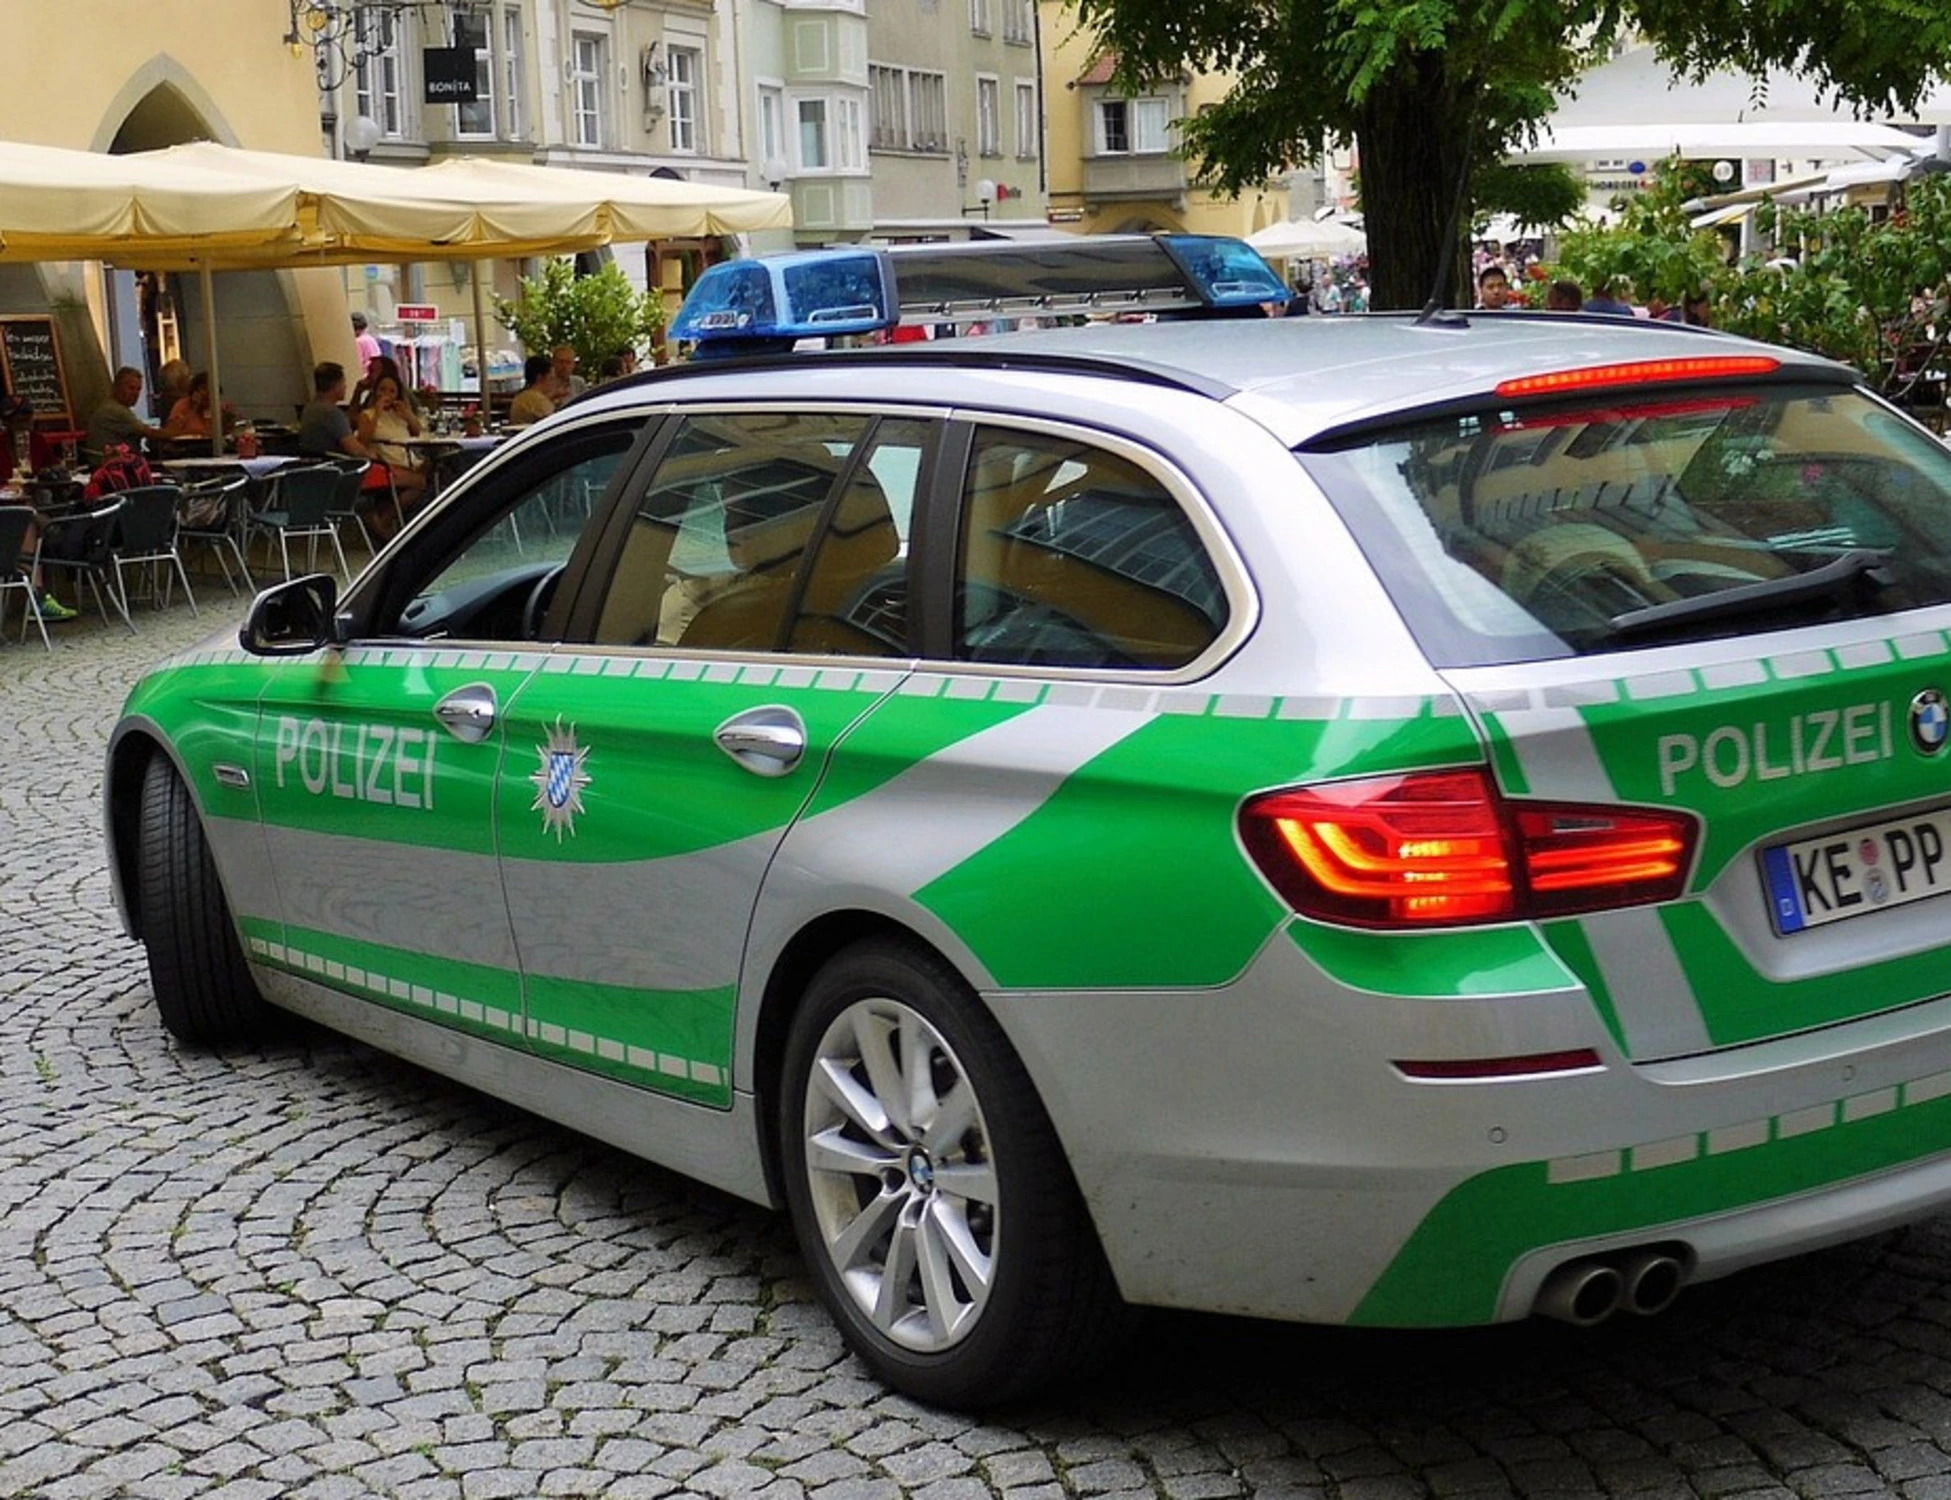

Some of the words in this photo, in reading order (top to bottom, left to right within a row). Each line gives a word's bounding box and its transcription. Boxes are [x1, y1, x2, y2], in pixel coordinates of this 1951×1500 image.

[429, 80, 471, 94] BONITA
[276, 716, 436, 810] POLIZEI
[1658, 701, 1894, 796] POLIZEI
[1794, 842, 1863, 915] KE
[1885, 823, 1943, 892] PP
